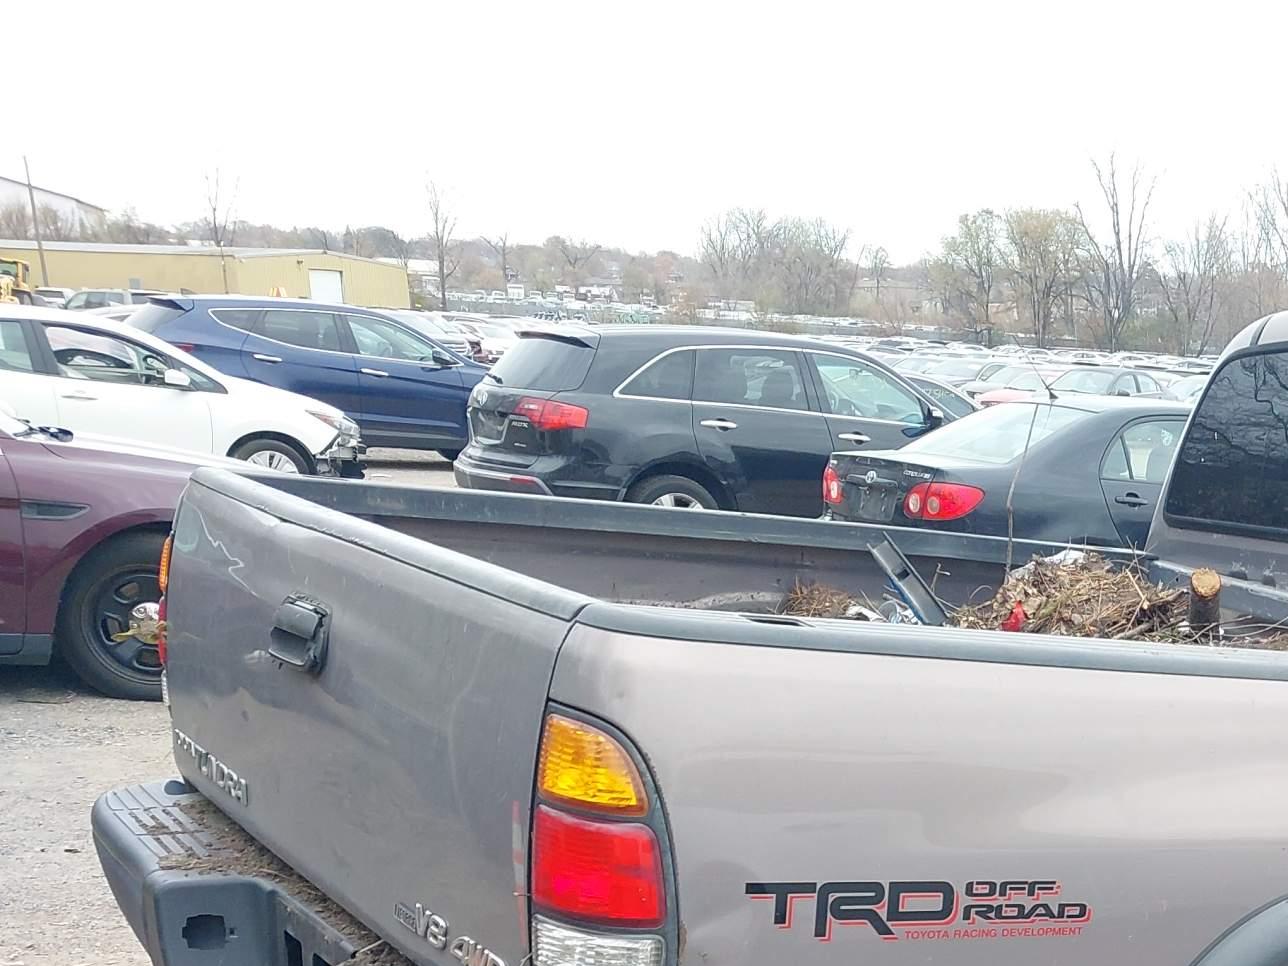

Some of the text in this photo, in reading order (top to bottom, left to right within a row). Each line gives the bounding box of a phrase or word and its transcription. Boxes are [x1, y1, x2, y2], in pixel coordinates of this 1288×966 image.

[193, 743, 249, 808] TUNDRA
[964, 880, 1061, 901] OFF
[415, 903, 448, 951] V8
[745, 880, 959, 942] TRD
[962, 903, 1092, 925] ROAD
[904, 926, 1084, 940] TOYOTA RACING DEVELOPMENT
